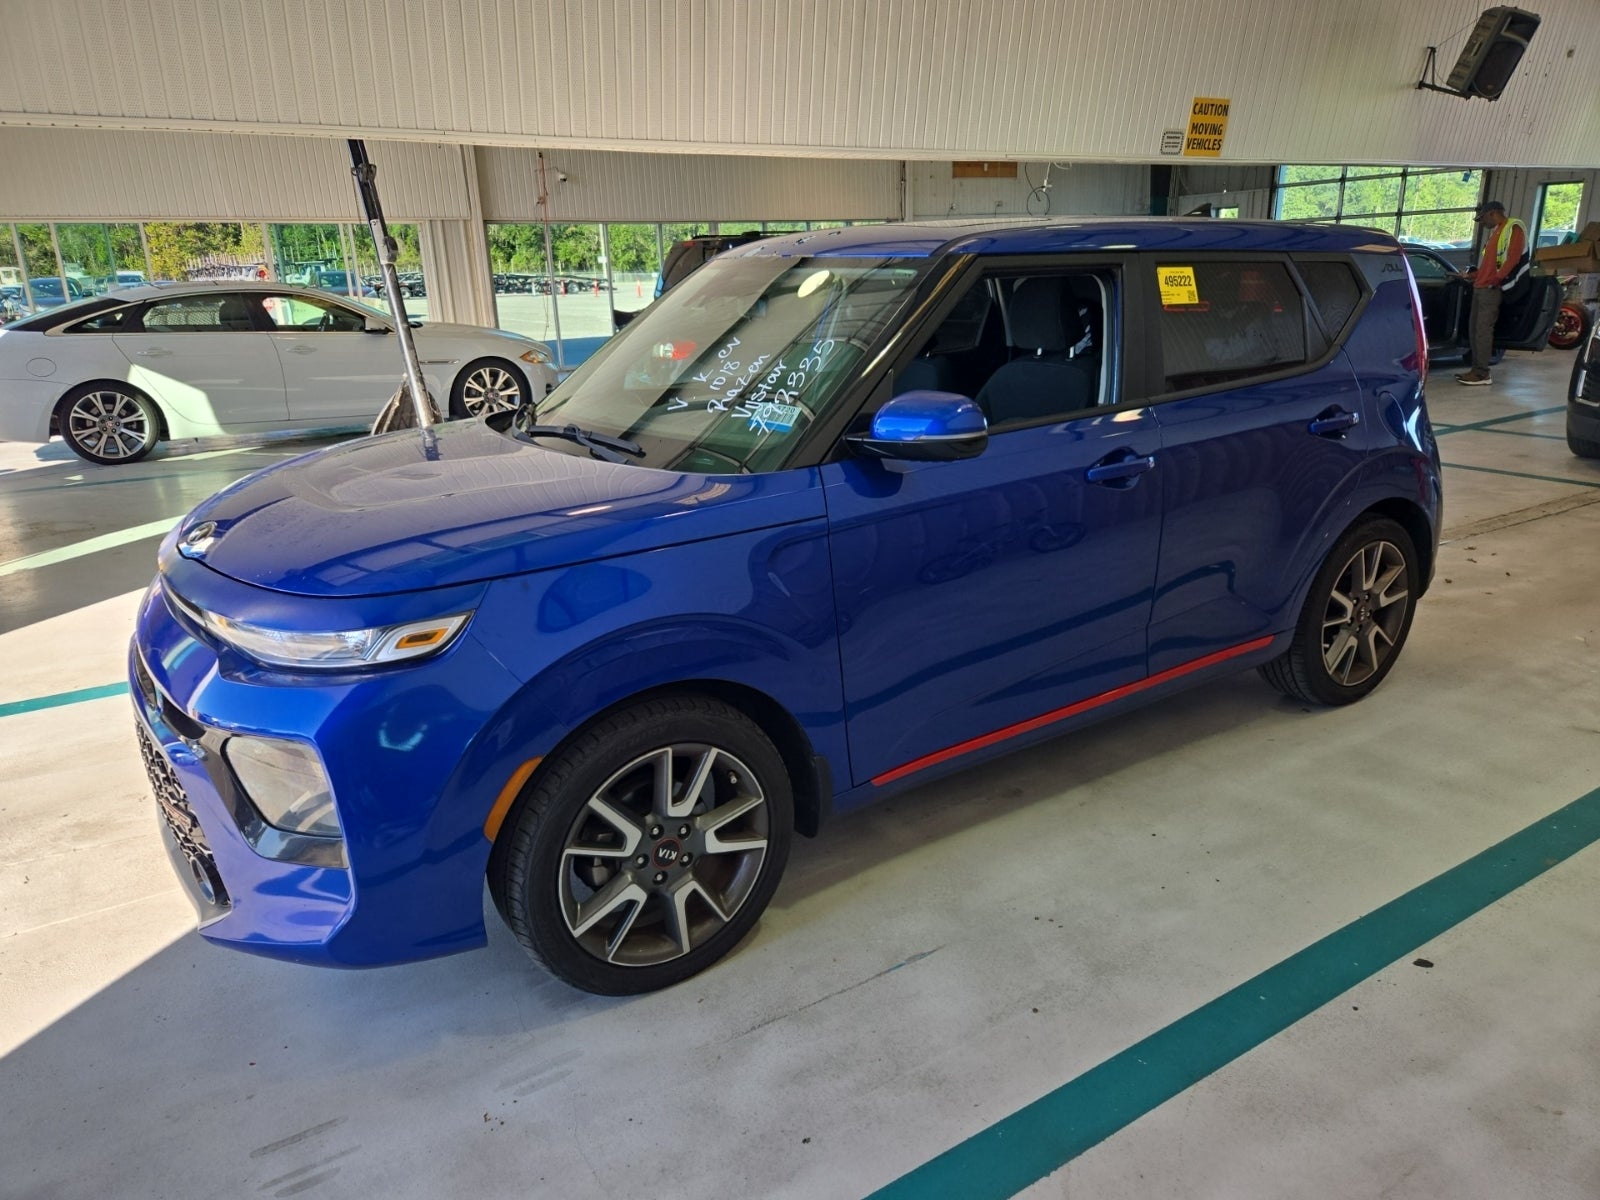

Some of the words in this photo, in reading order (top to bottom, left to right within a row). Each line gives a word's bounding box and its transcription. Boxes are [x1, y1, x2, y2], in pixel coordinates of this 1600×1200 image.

[1192, 102, 1230, 117] CAUTION
[1190, 122, 1224, 136] MOVING
[1186, 137, 1223, 151] VEHICLES
[1164, 275, 1193, 287] 495222
[658, 847, 678, 860] KIA
